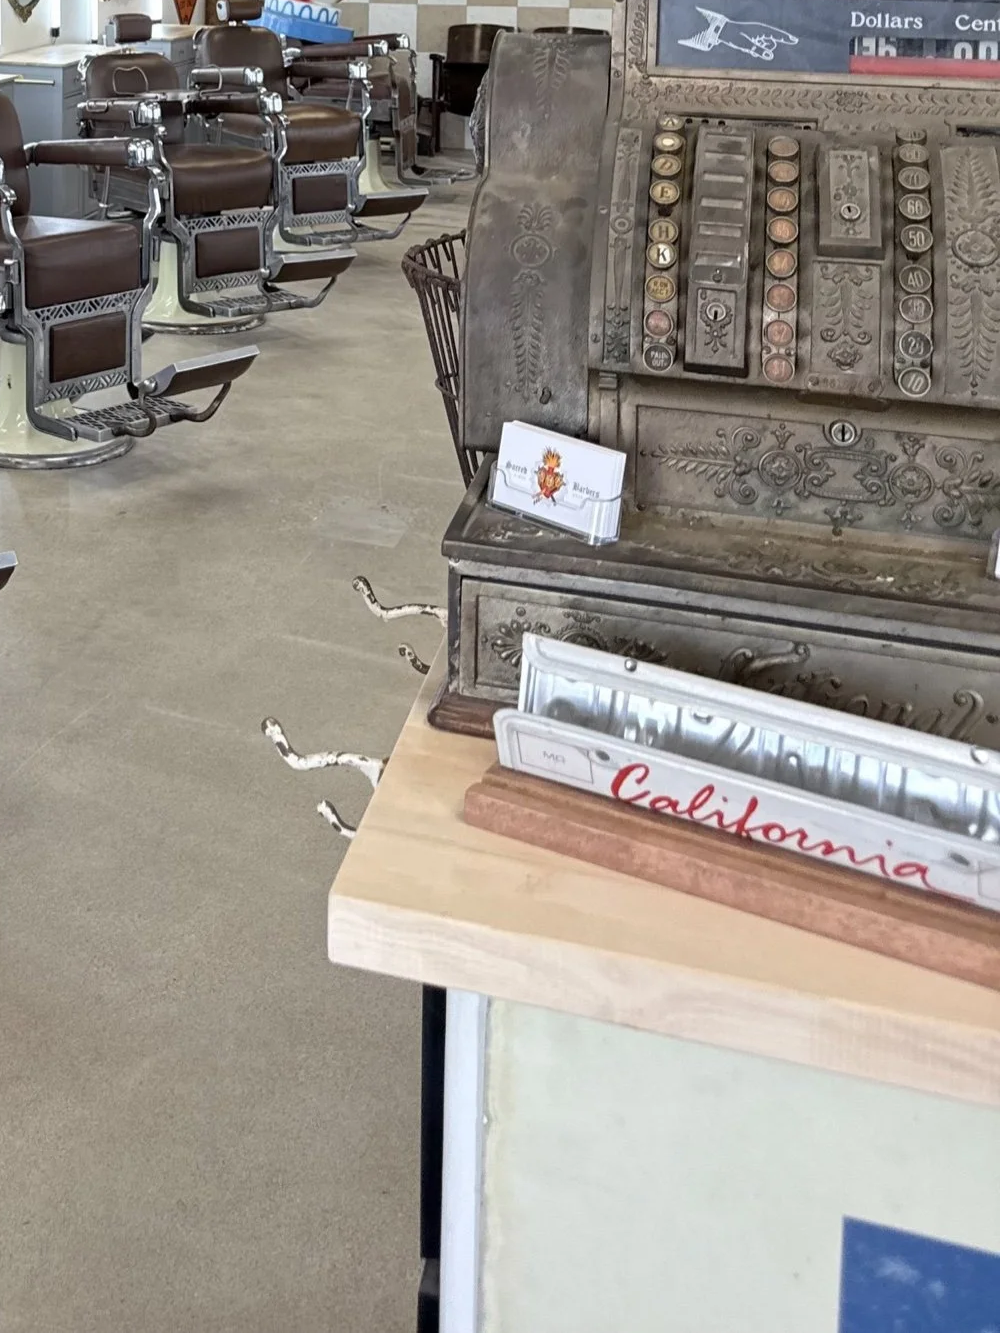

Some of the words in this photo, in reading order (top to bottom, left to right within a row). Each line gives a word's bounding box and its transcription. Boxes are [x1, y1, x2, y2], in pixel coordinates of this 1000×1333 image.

[850, 11, 923, 29] Dollars
[660, 186, 671, 199] E
[907, 199, 923, 216] 60
[908, 230, 925, 247] 50
[657, 248, 667, 261] K
[907, 271, 923, 287] 40
[907, 373, 924, 392] 10
[610, 762, 975, 902] California
